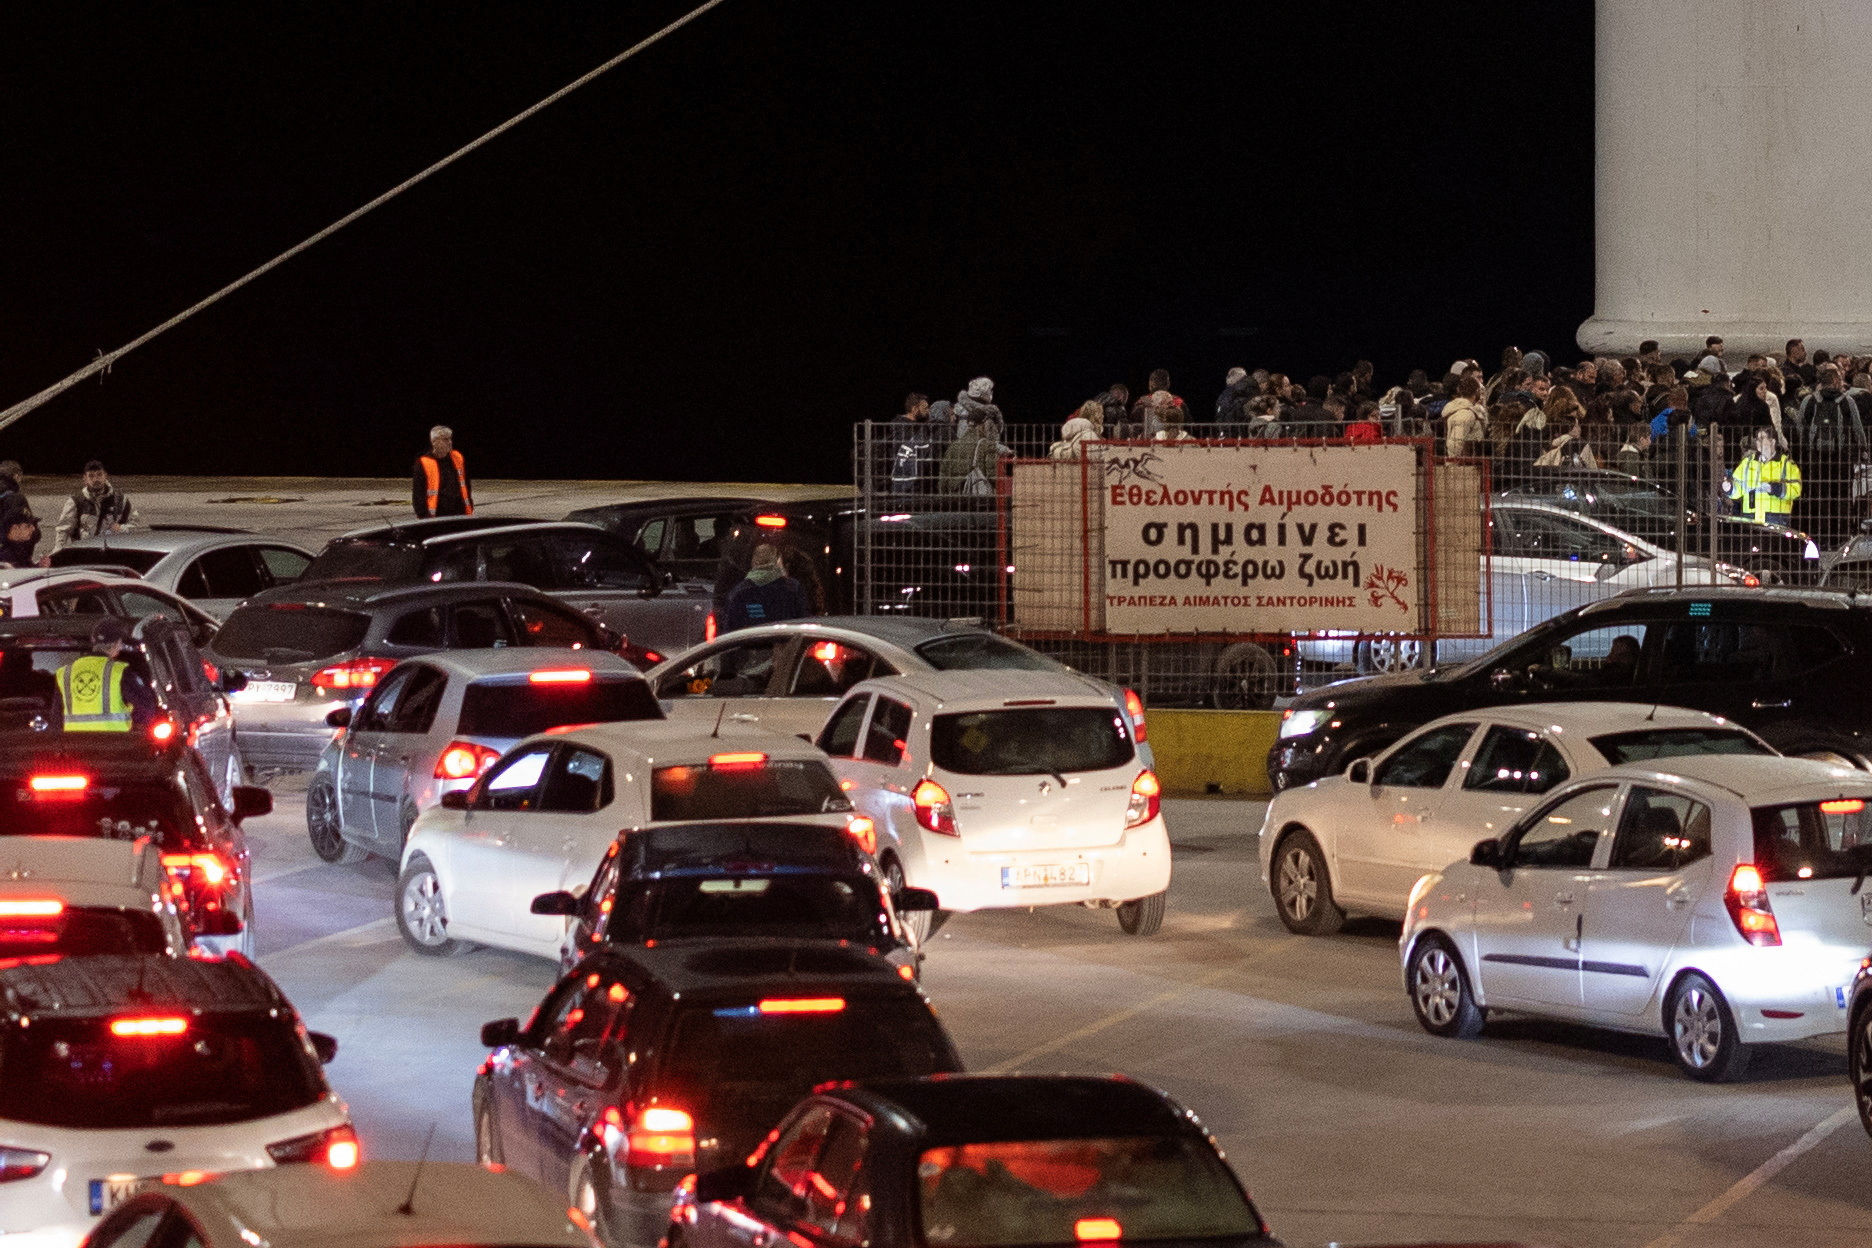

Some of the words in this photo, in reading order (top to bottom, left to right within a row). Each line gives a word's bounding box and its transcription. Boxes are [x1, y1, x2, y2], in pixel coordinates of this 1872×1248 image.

[1110, 484, 1250, 512] Εθελοντής
[1258, 483, 1399, 512] Αιμοδότης
[1141, 512, 1368, 555] σημαίνει
[1108, 551, 1286, 587] προσφέρω
[1297, 551, 1361, 587] ζωή
[1107, 594, 1178, 608] ΤΡΑΠΕΖΑ
[1182, 594, 1252, 608] ΑΙΜΑΤΟΣ
[1255, 594, 1357, 608] ΣΑΝΤΟΡΙΝΗΣ
